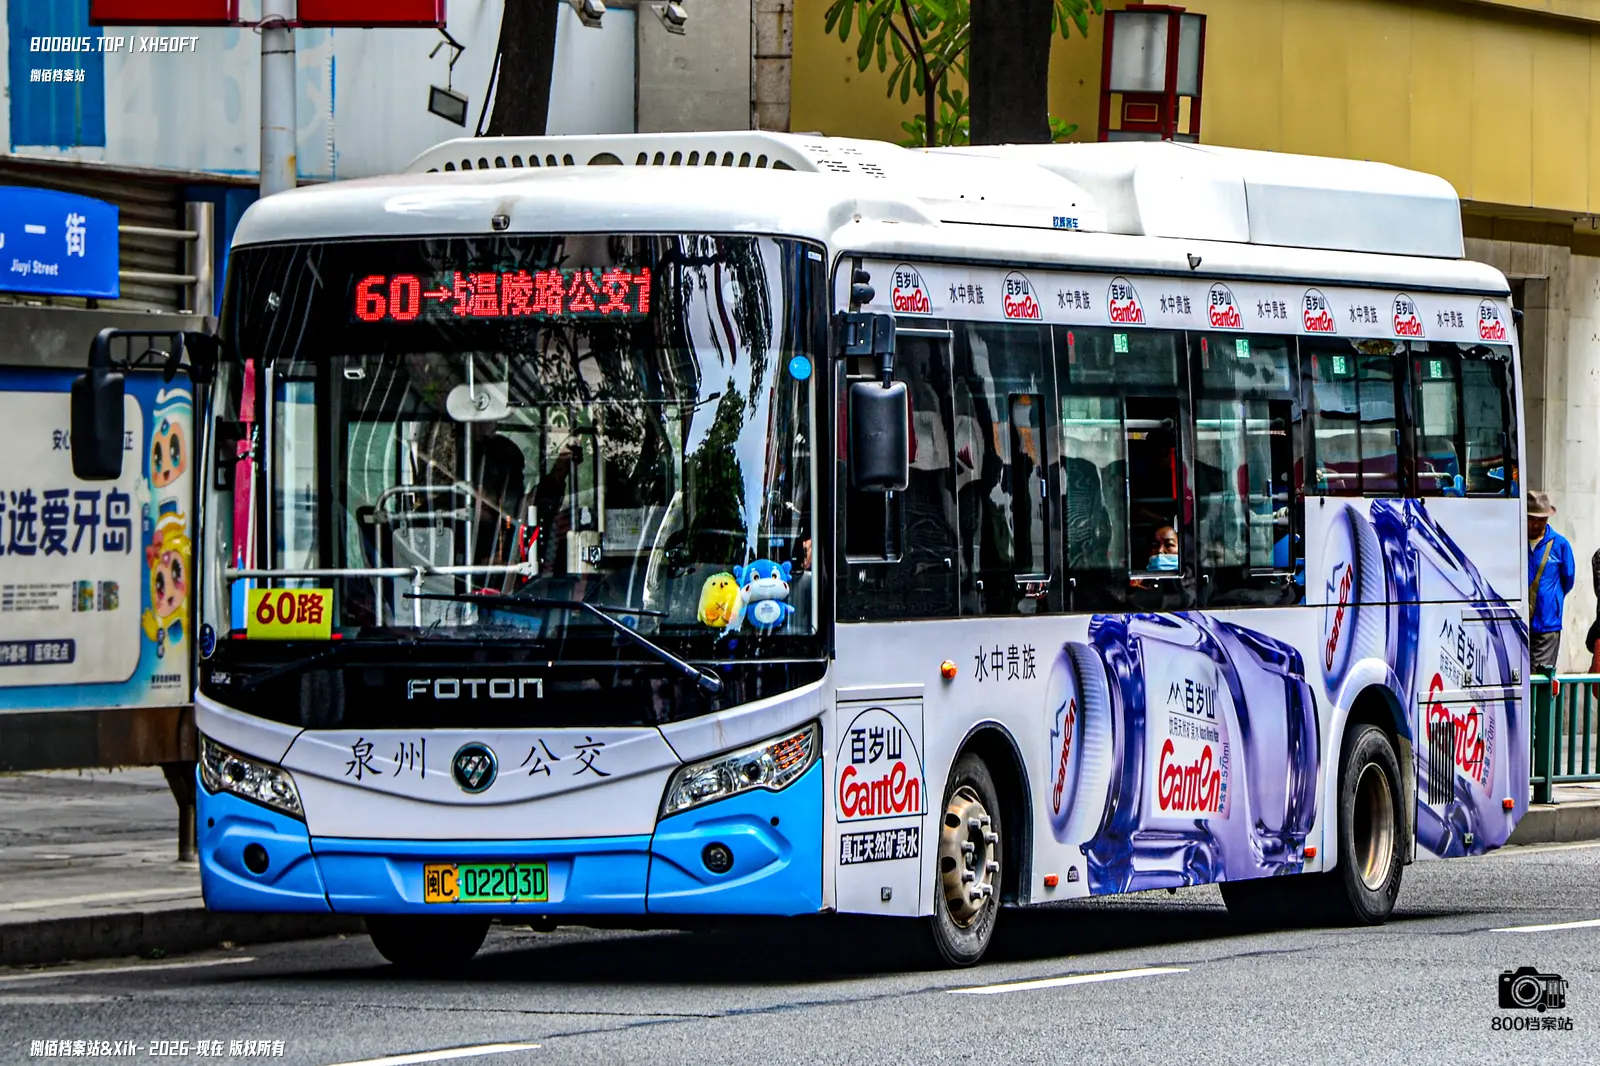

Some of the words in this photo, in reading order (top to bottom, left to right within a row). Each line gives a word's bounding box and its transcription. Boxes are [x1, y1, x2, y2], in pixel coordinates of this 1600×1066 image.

[0, 212, 86, 257] 一街
[33, 260, 58, 276] Street
[895, 272, 919, 288] 百岁山
[1006, 280, 1029, 295] 百岁山
[356, 275, 420, 320] 60
[949, 283, 984, 304] 水中贵族
[1057, 289, 1091, 311] 水中贵族
[1111, 285, 1133, 300] 百岁山
[1211, 290, 1231, 305] 百岁山
[1305, 295, 1325, 310] 百岁山
[1160, 294, 1191, 315] 水中贵族
[1257, 300, 1287, 319] 水中贵族
[1349, 305, 1378, 324] 水中贵族
[1396, 300, 1414, 315] 百岁山
[1481, 305, 1498, 320] 百岁山
[1437, 310, 1464, 328] 水中贵族
[256, 593, 323, 625] 60路
[975, 643, 1036, 682] 水中贵族
[1457, 624, 1484, 686] 百岁山
[407, 678, 544, 699] FOTON
[1185, 678, 1215, 719] 百岁山
[851, 726, 901, 764] 百岁山
[345, 737, 426, 781] 泉州
[520, 737, 612, 777] 公交
[1158, 738, 1221, 812] Ganten
[840, 761, 919, 817] Ganten
[841, 828, 918, 864] 真正天然矿泉水
[465, 868, 545, 896] 02203D
